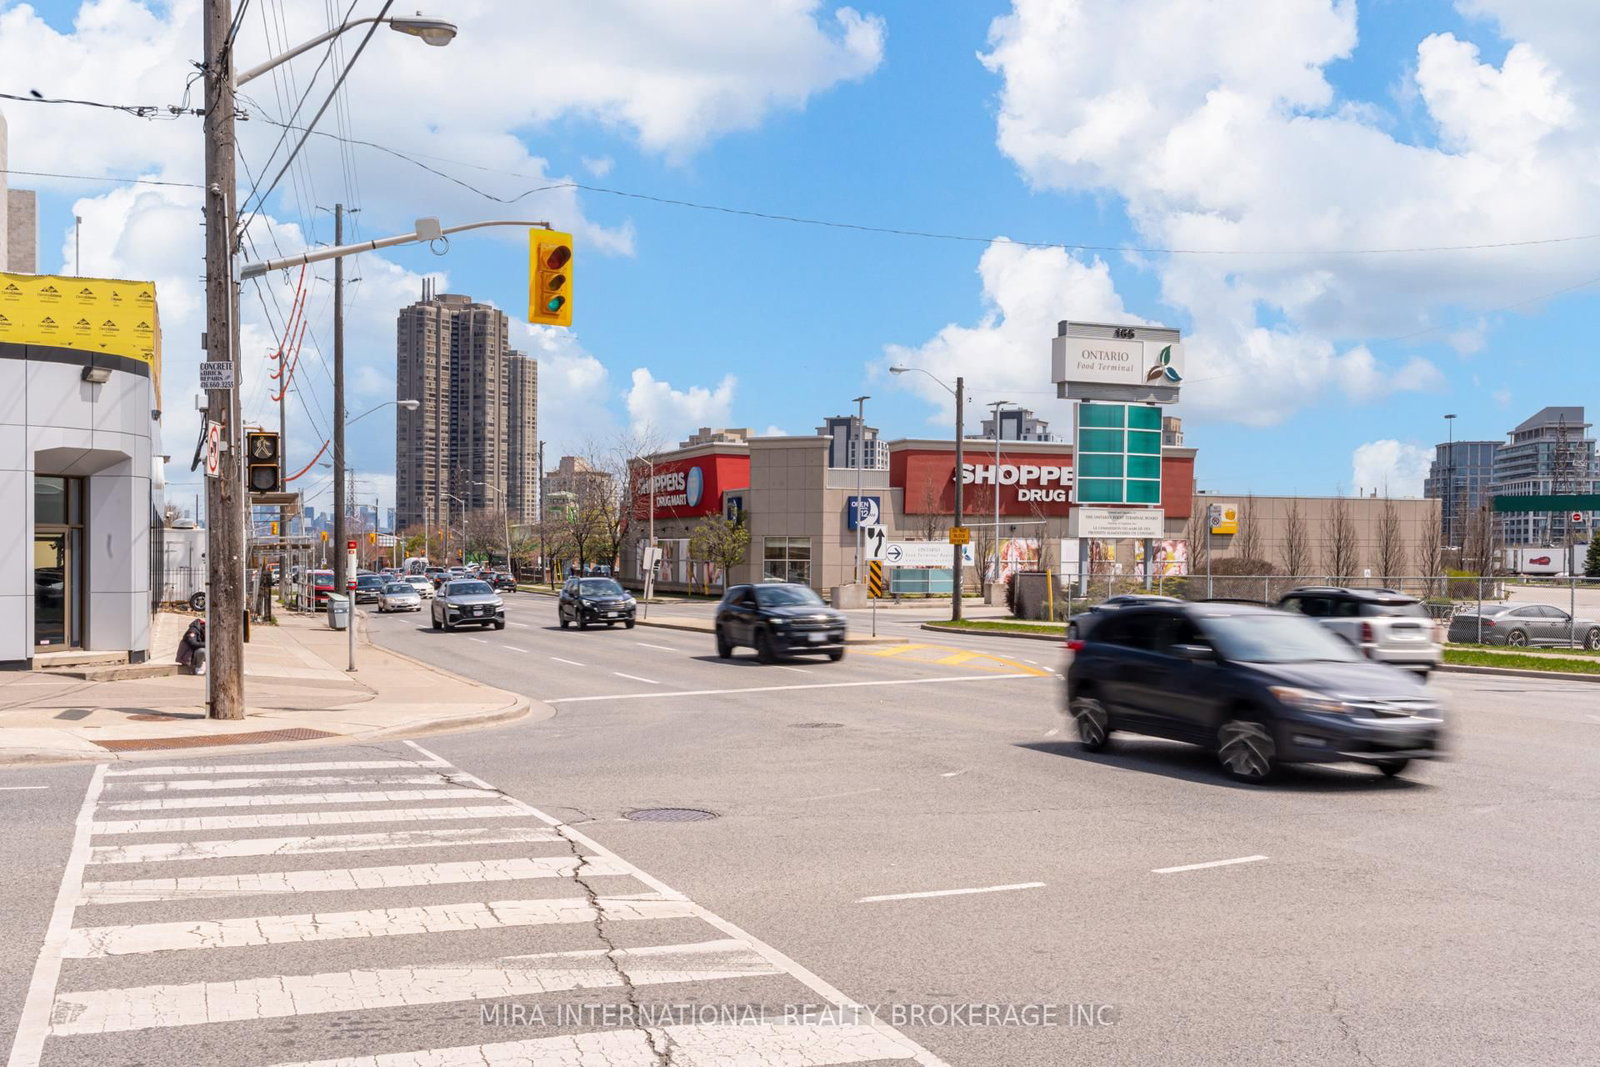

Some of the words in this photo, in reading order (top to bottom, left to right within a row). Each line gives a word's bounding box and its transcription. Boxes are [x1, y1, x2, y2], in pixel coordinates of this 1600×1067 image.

[1081, 350, 1129, 361] ONTARIO
[200, 362, 233, 370] CONCRETE
[1077, 362, 1095, 370] Food
[1098, 363, 1134, 372] Terminal
[1018, 489, 1066, 502] DRUG
